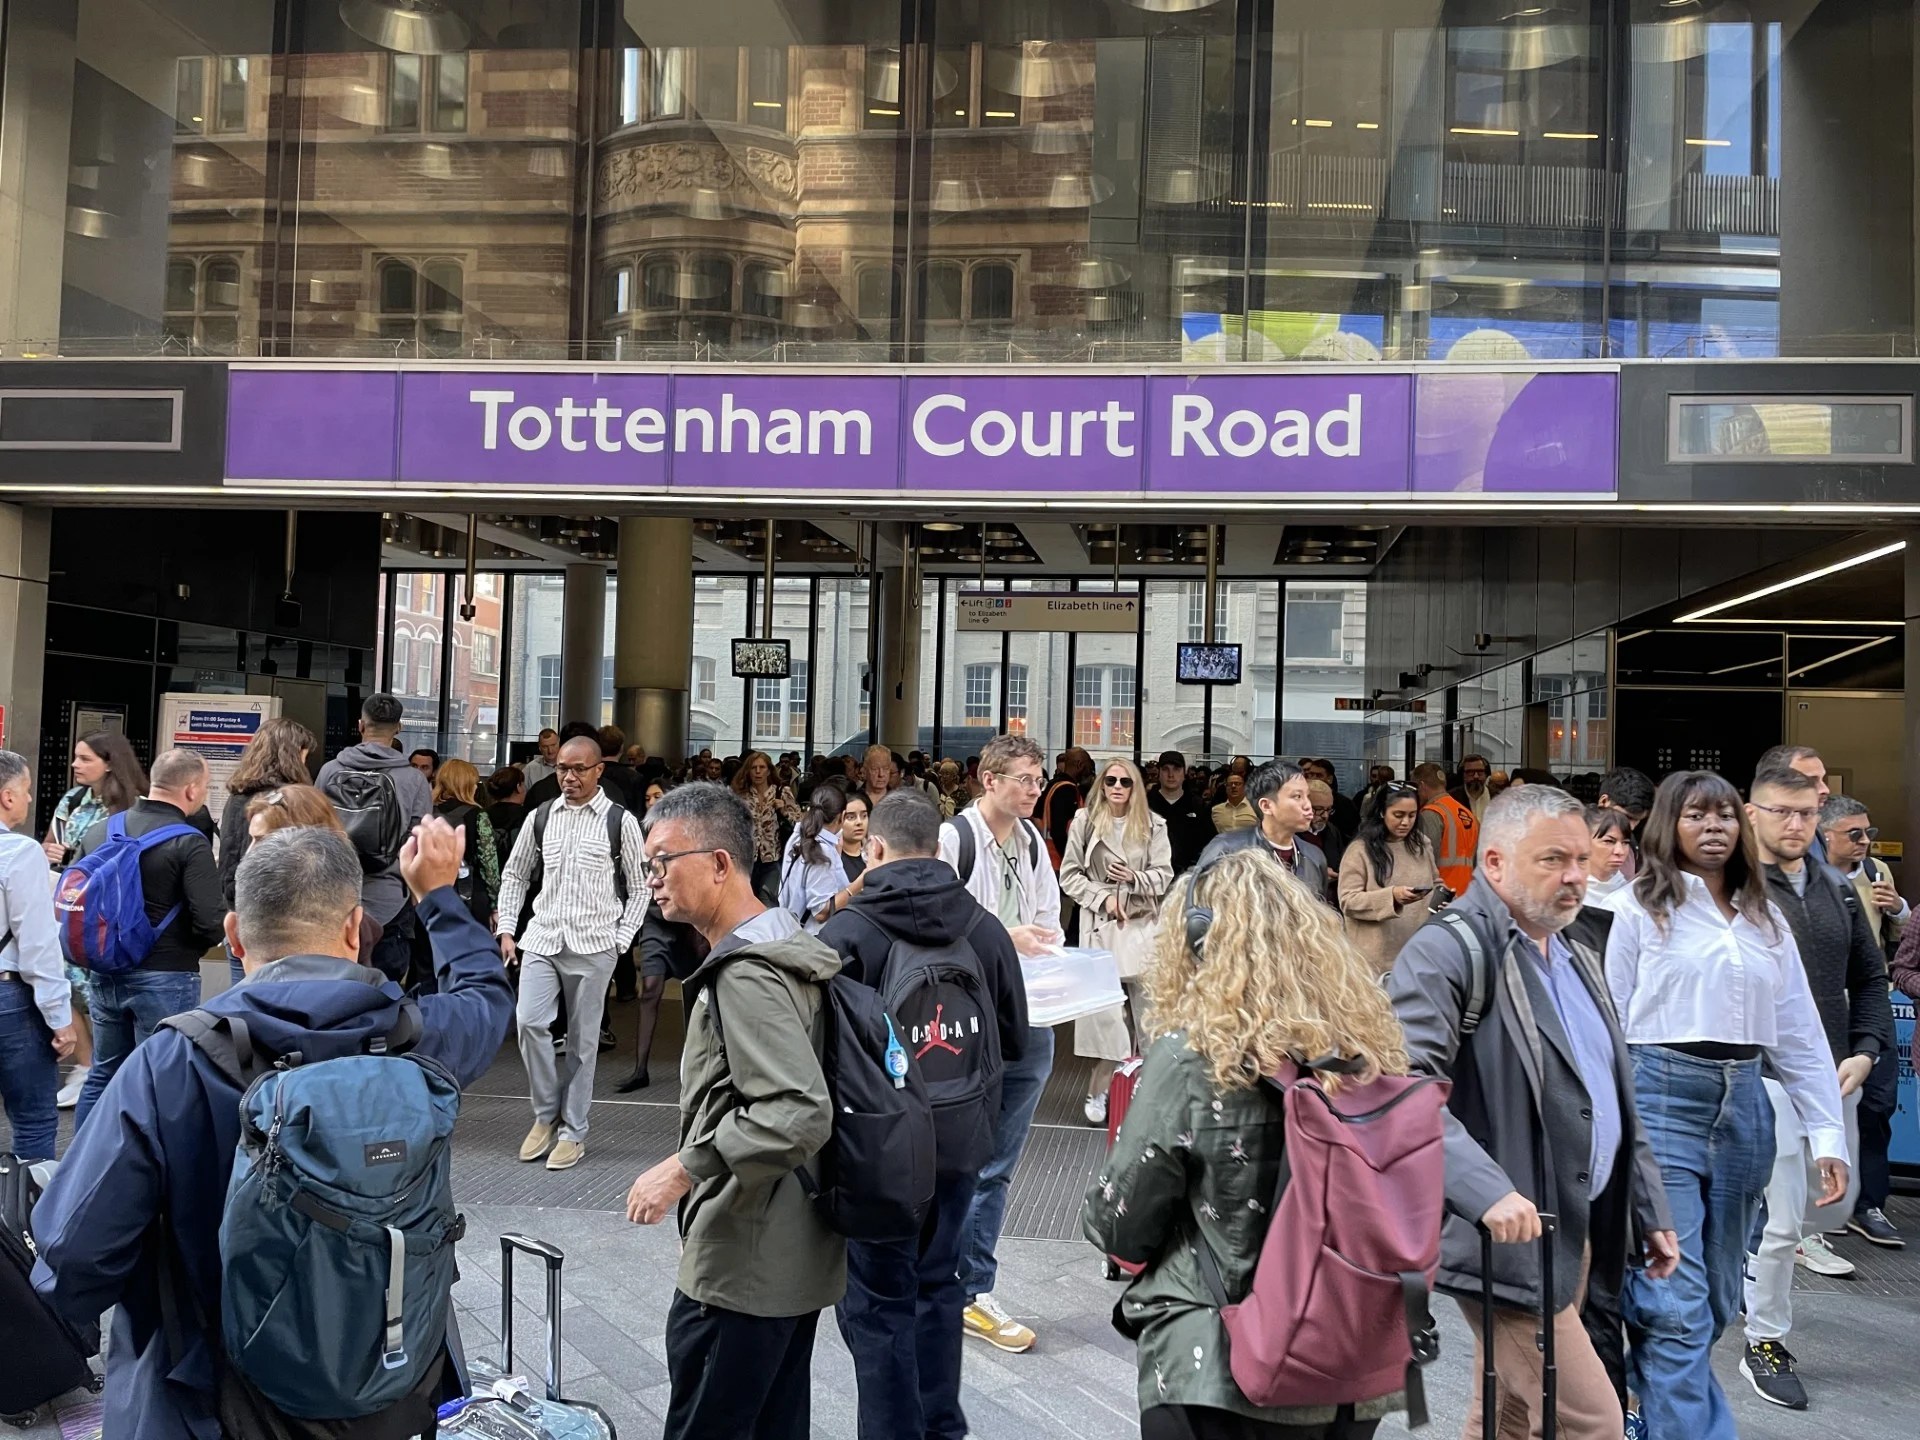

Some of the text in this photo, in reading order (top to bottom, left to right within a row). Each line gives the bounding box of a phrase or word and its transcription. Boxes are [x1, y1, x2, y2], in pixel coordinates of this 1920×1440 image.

[470, 391, 1362, 457] Tottenham Court Road
[1047, 601, 1123, 610] Elizabeth line
[902, 1016, 979, 1043] ORDAN
